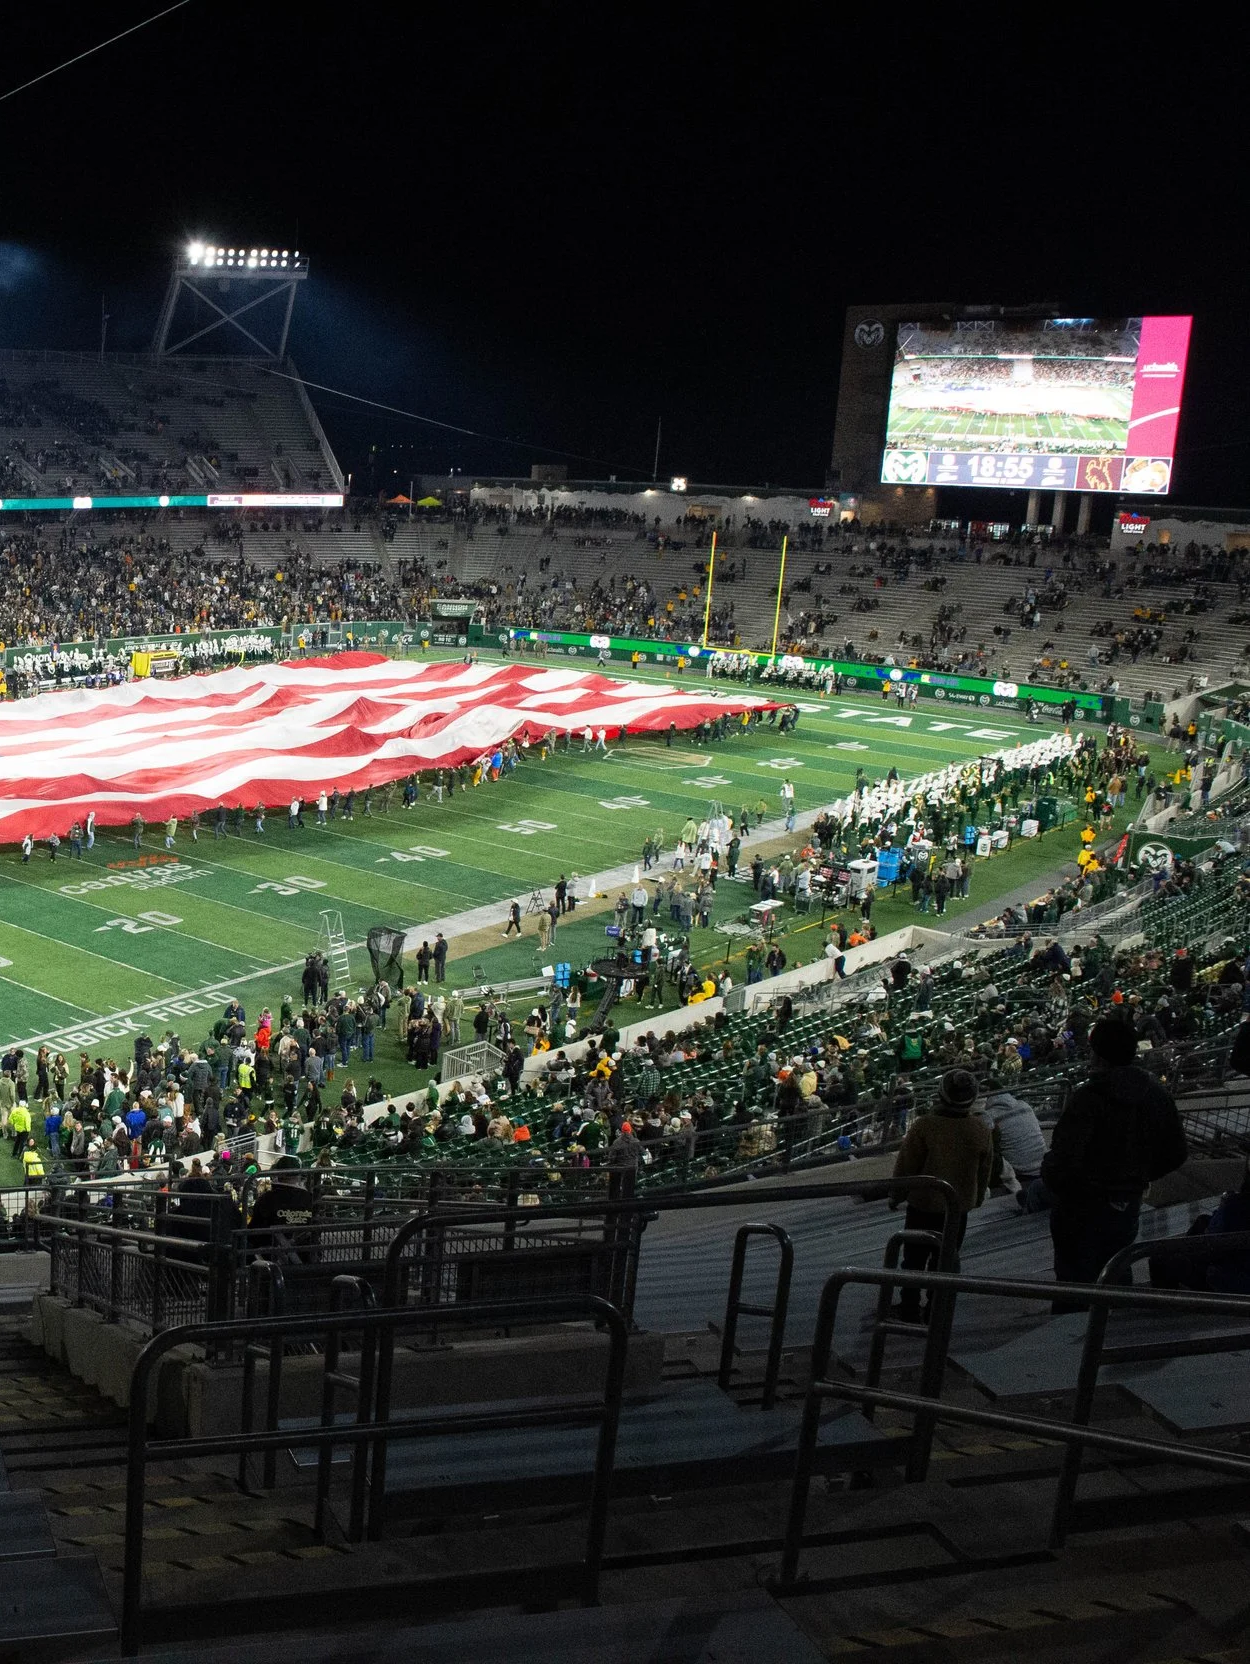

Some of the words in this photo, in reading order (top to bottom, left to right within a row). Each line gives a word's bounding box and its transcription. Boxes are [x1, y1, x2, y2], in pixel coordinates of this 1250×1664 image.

[968, 456, 1034, 478] 18:55
[1121, 523, 1146, 531] LIGHT
[797, 702, 1020, 741] STATE
[495, 819, 558, 835] 50
[389, 845, 451, 862] 40
[59, 862, 192, 895] canvas
[130, 869, 215, 891] stadium
[256, 875, 328, 896] 30
[106, 910, 184, 934] 20
[23, 1015, 149, 1060] LUBICK
[144, 991, 237, 1022] FIELD
[291, 1128, 298, 1138] 11
[276, 1209, 312, 1218] Colorado
[285, 1216, 308, 1224] State
